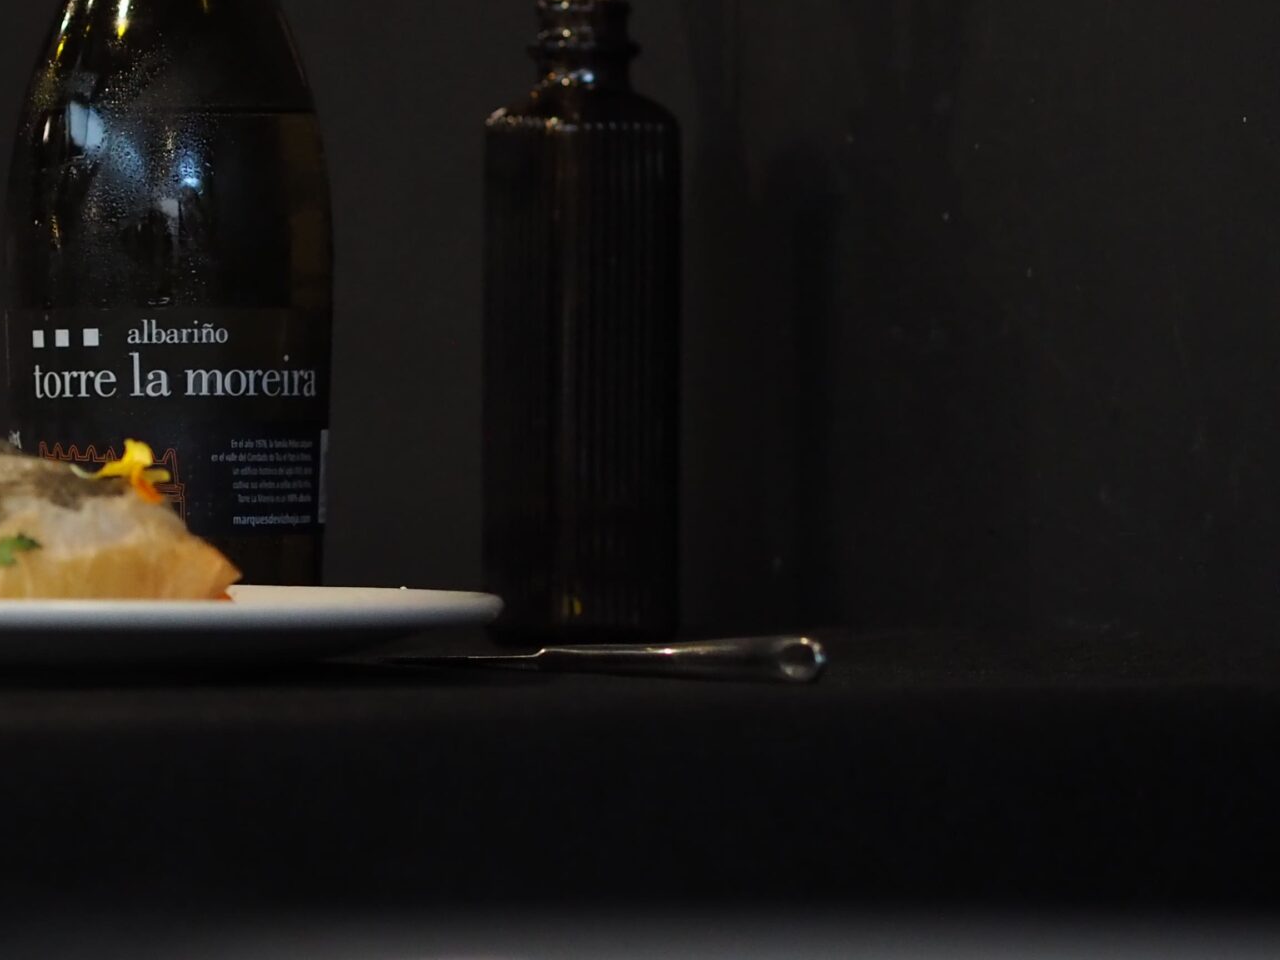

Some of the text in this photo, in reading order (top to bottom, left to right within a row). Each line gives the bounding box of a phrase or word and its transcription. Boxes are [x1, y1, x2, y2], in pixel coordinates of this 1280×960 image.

[127, 319, 229, 344] albariño
[33, 351, 317, 400] torre la moreira
